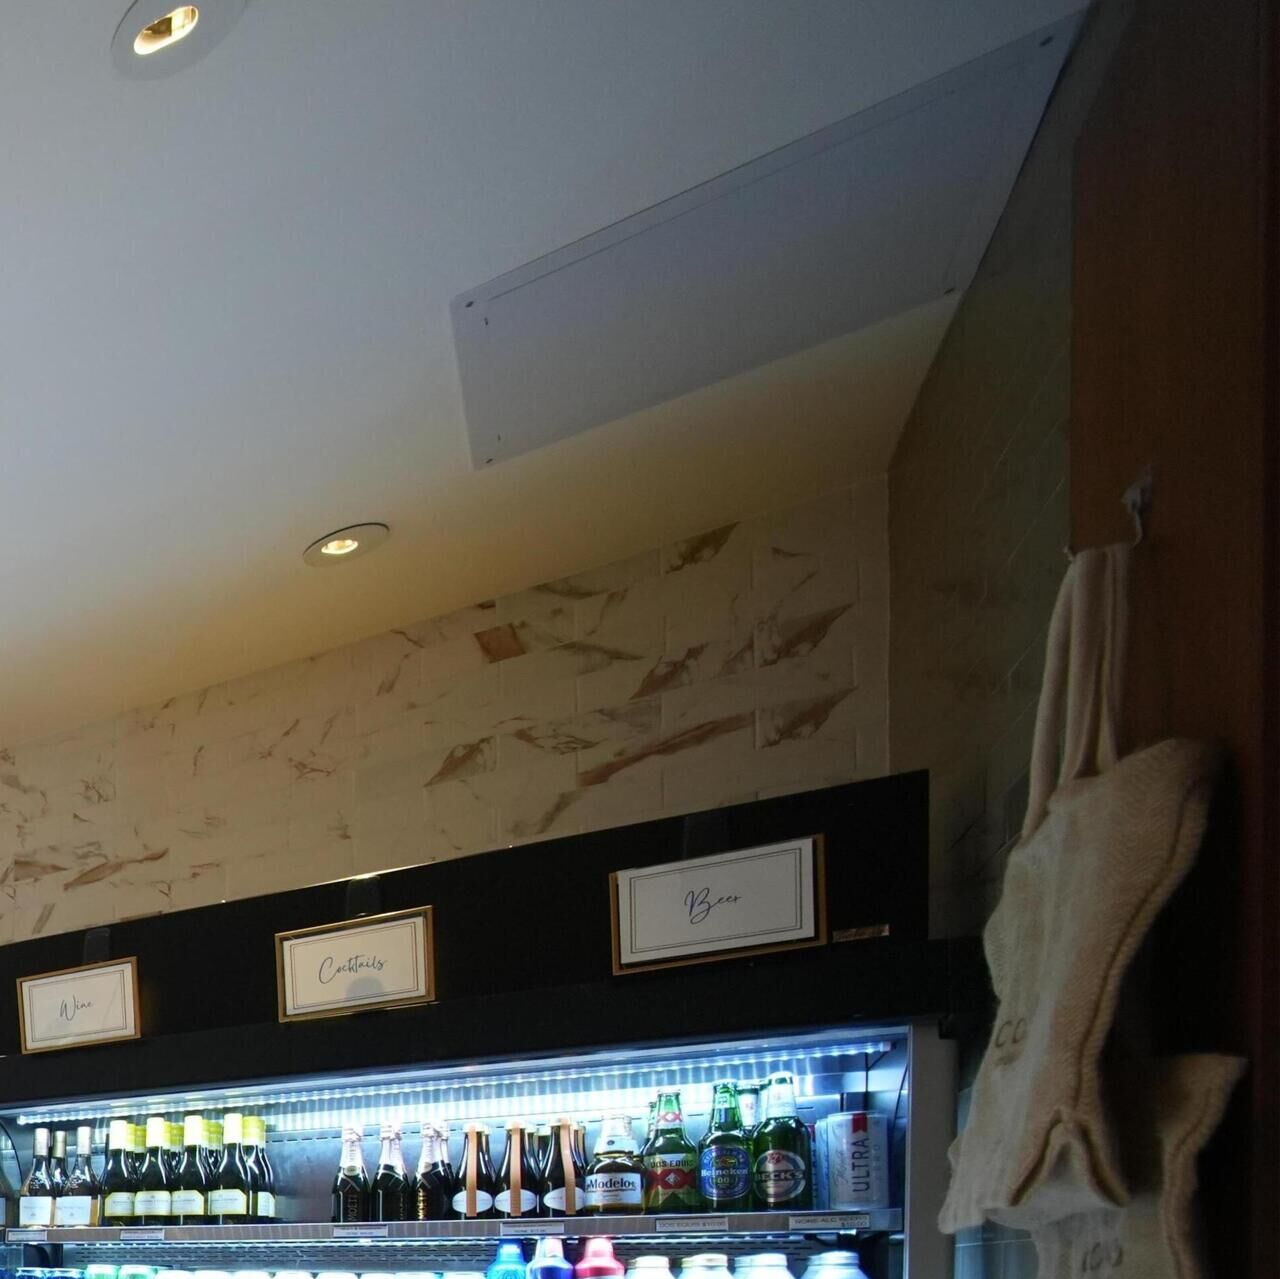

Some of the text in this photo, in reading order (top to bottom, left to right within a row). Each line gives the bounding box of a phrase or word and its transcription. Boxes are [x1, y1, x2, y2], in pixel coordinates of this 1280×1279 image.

[684, 887, 742, 924] Beer
[318, 954, 386, 984] Cocktails
[60, 995, 94, 1022] Wine
[701, 1168, 748, 1177] Heineken
[852, 1138, 870, 1193] ULTRA
[590, 1177, 631, 1190] Modelo
